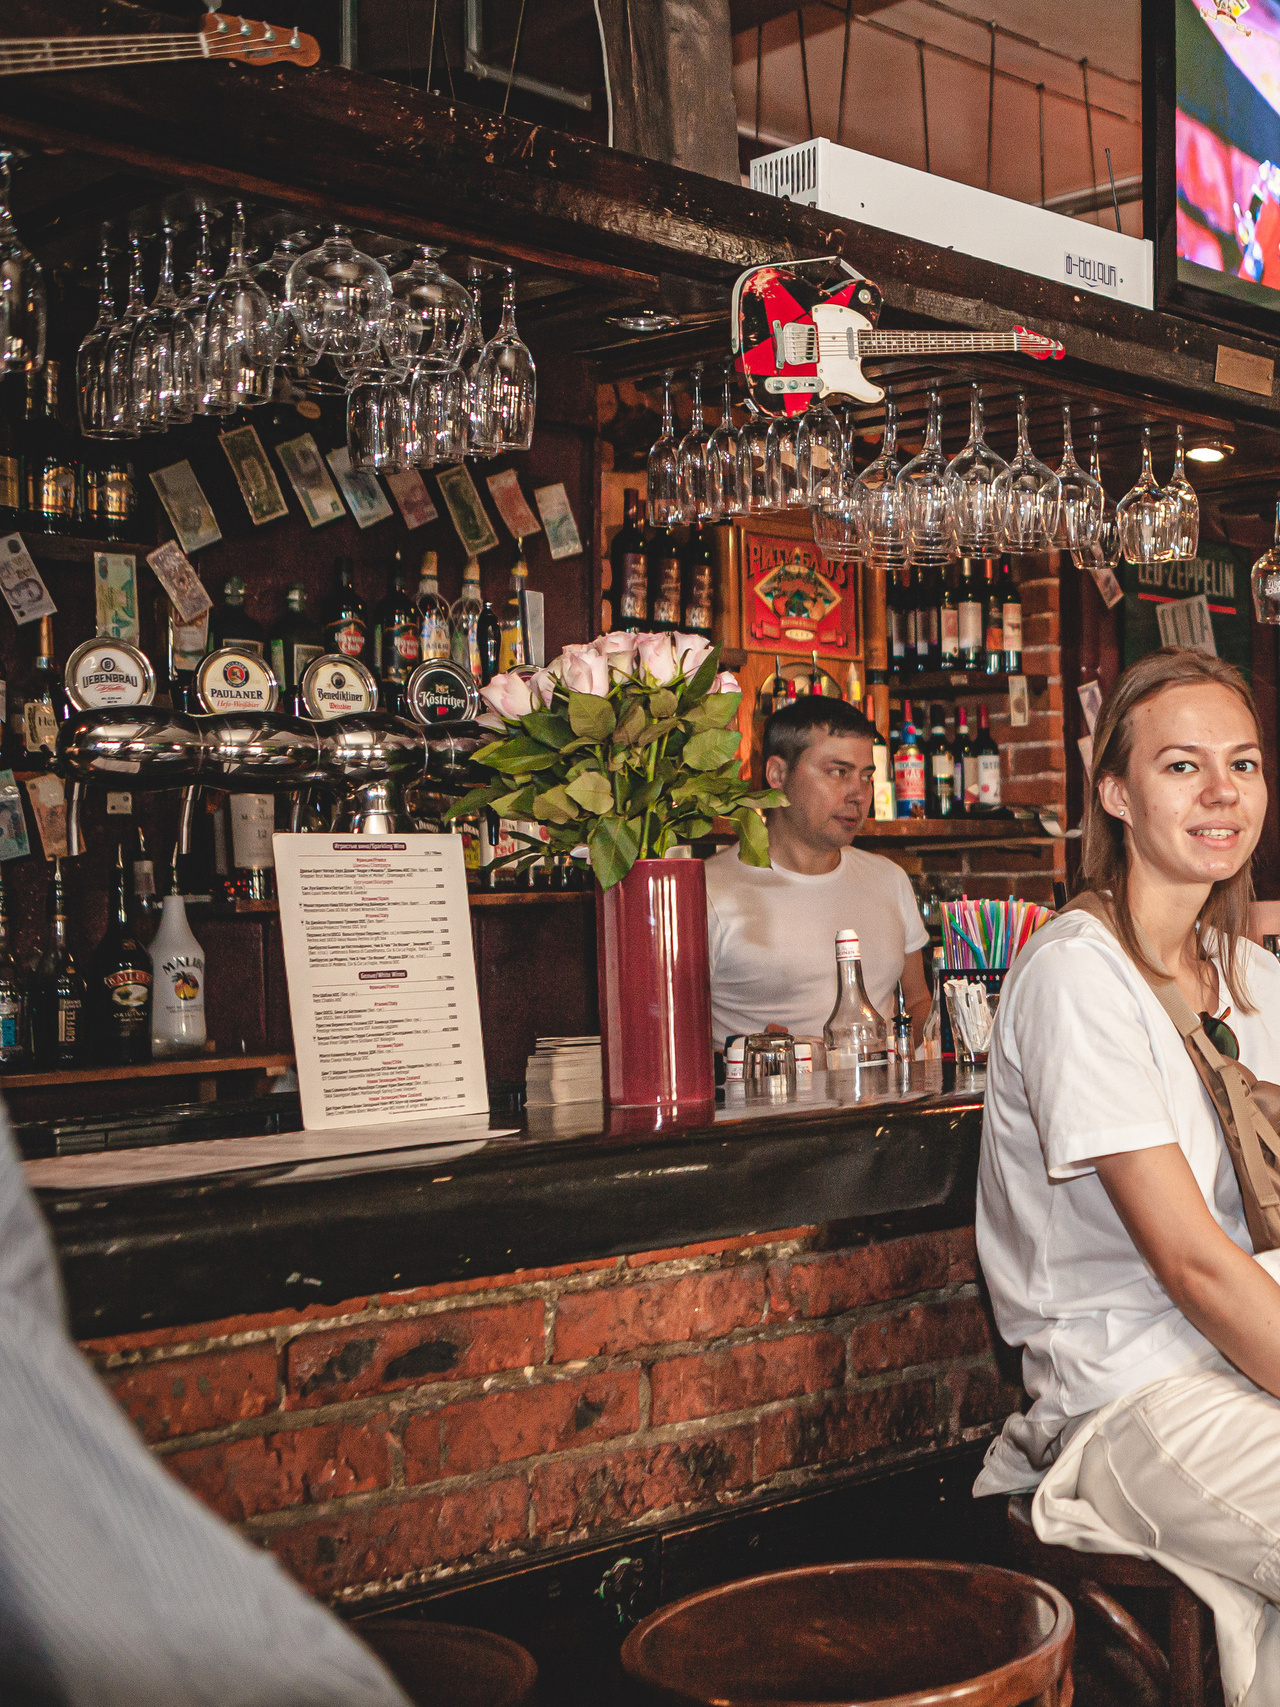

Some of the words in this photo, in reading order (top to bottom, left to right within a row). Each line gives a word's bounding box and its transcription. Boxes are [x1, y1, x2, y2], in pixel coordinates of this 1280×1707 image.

[210, 688, 264, 700] PAULANER
[316, 688, 364, 702] Benediktiner
[65, 1010, 76, 1042] COFFEE
